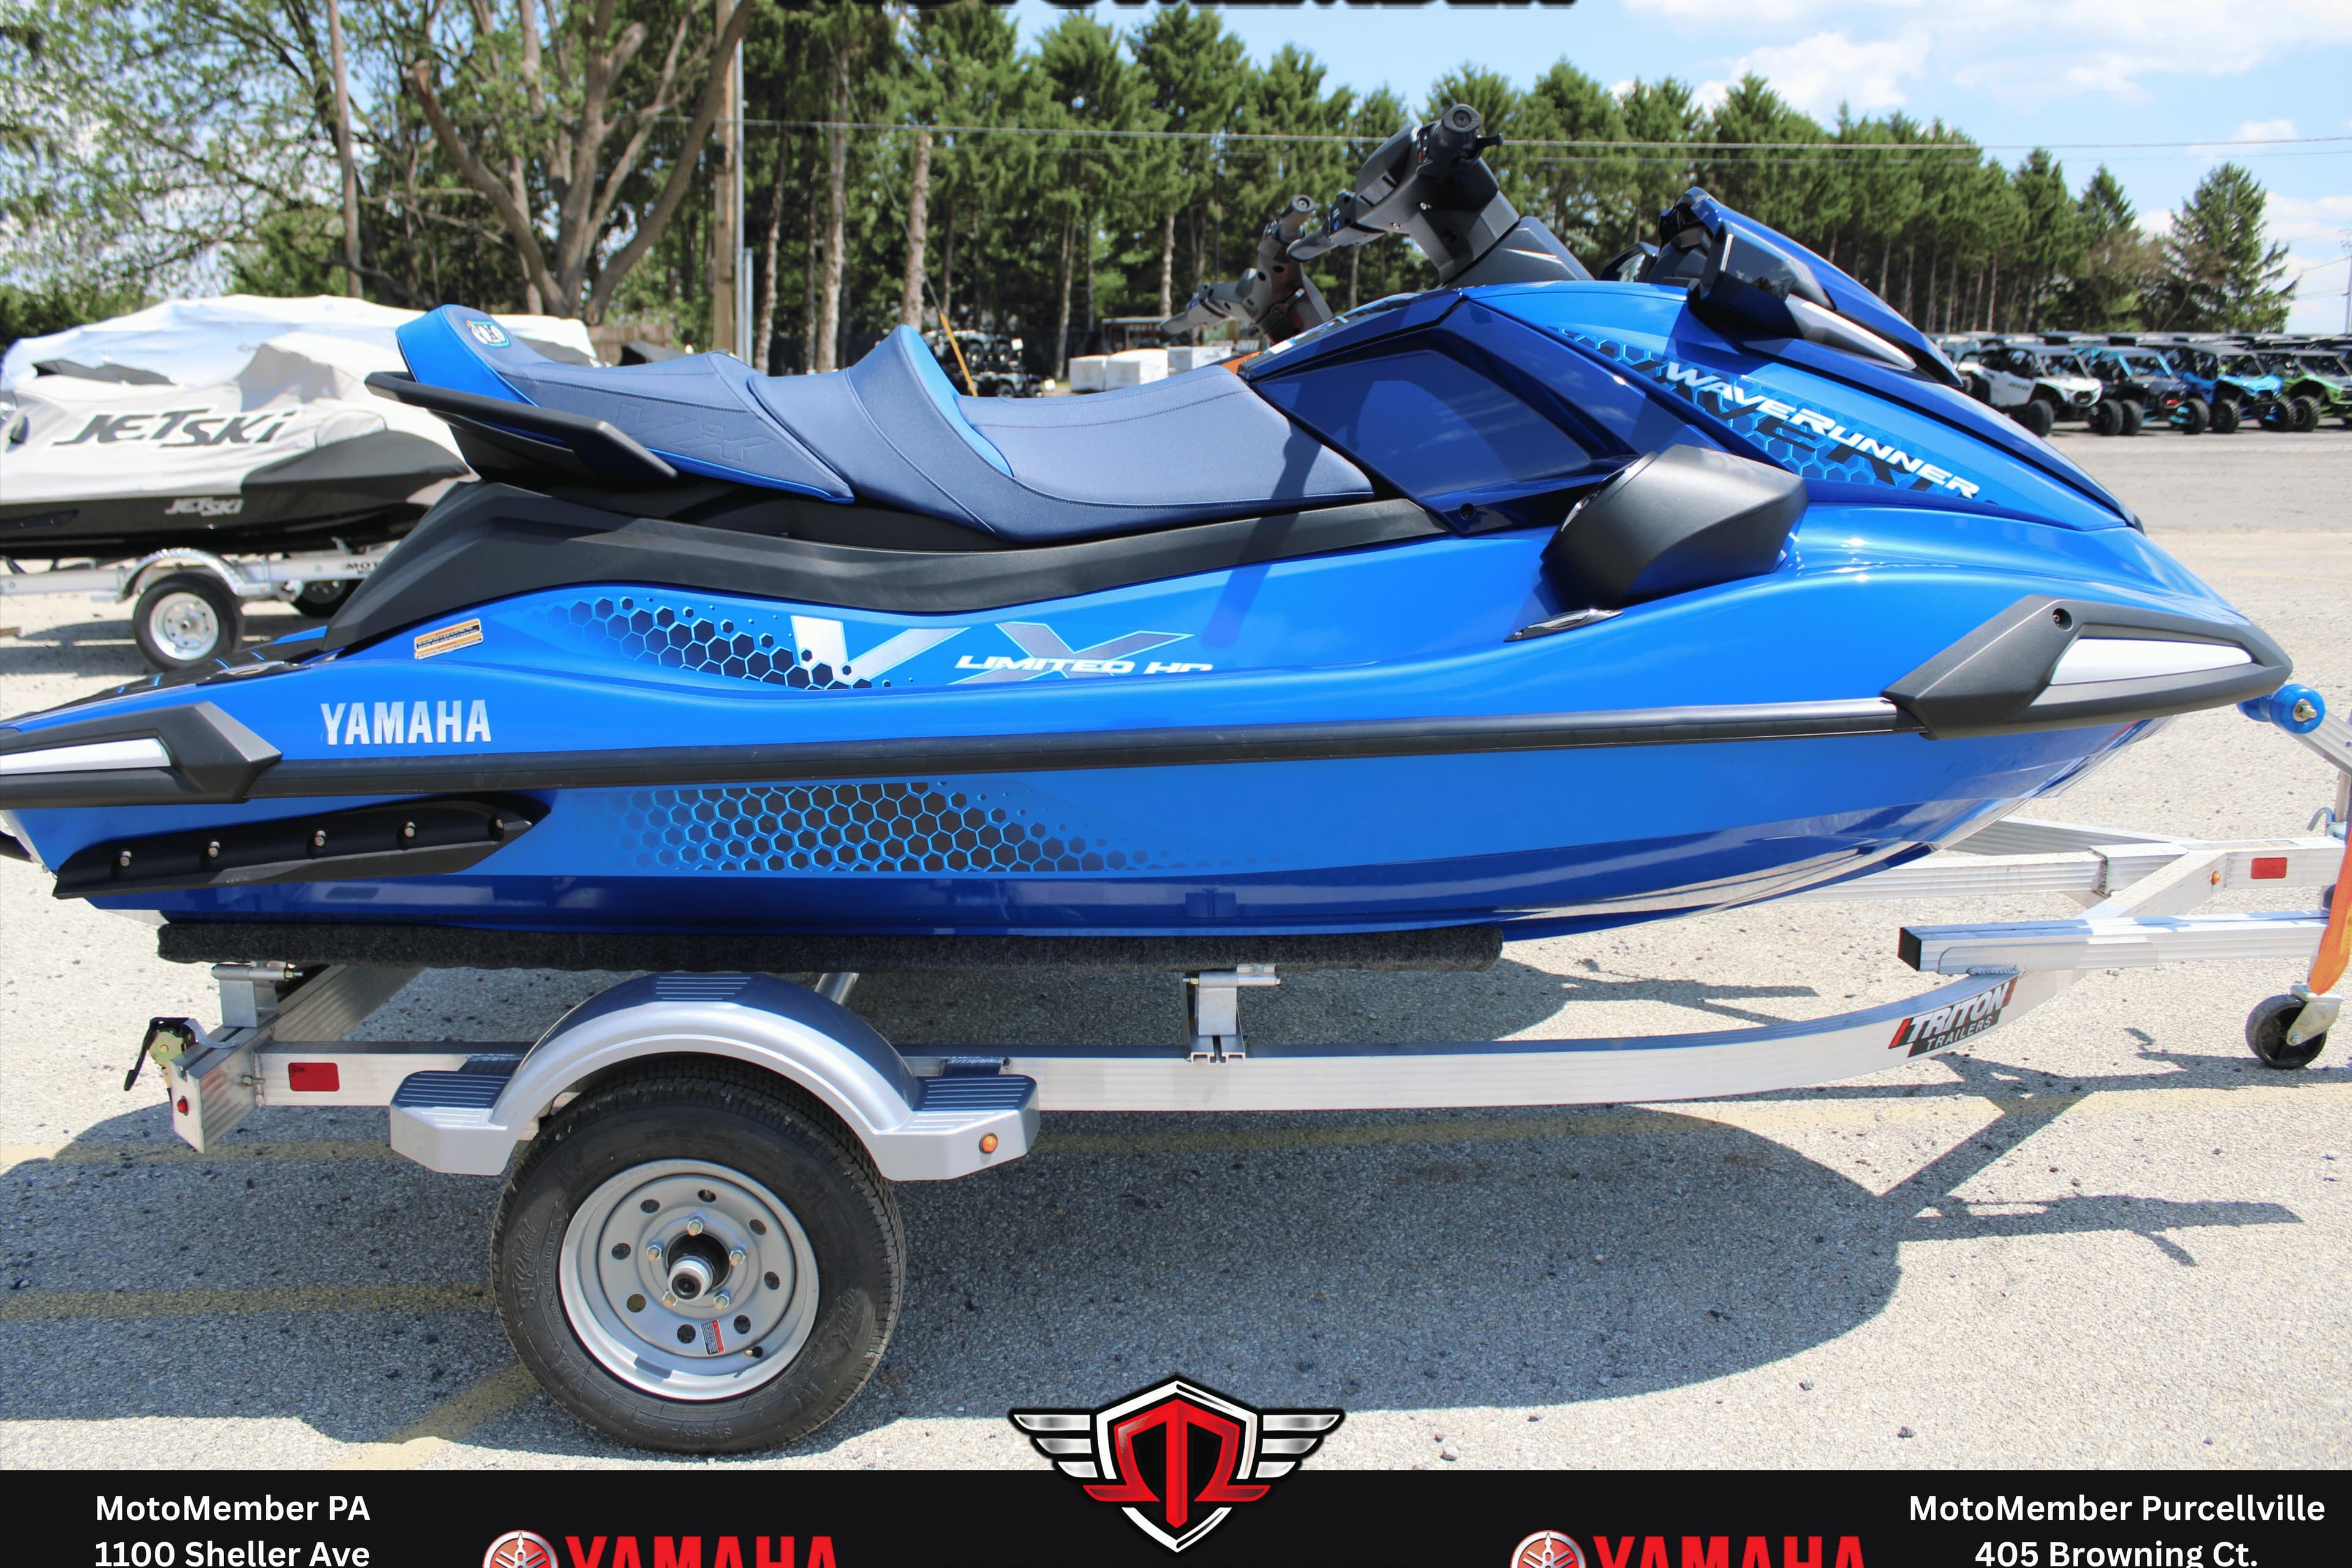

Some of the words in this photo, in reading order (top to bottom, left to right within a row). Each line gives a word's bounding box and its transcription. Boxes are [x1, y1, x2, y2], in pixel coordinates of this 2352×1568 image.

[1667, 361, 1980, 499] WAVERUNNER
[954, 655, 1136, 674] LIMITED
[321, 700, 491, 745] YAMAHA
[1907, 982, 2010, 1042] TRITON
[1926, 1016, 1992, 1050] TRAILERS
